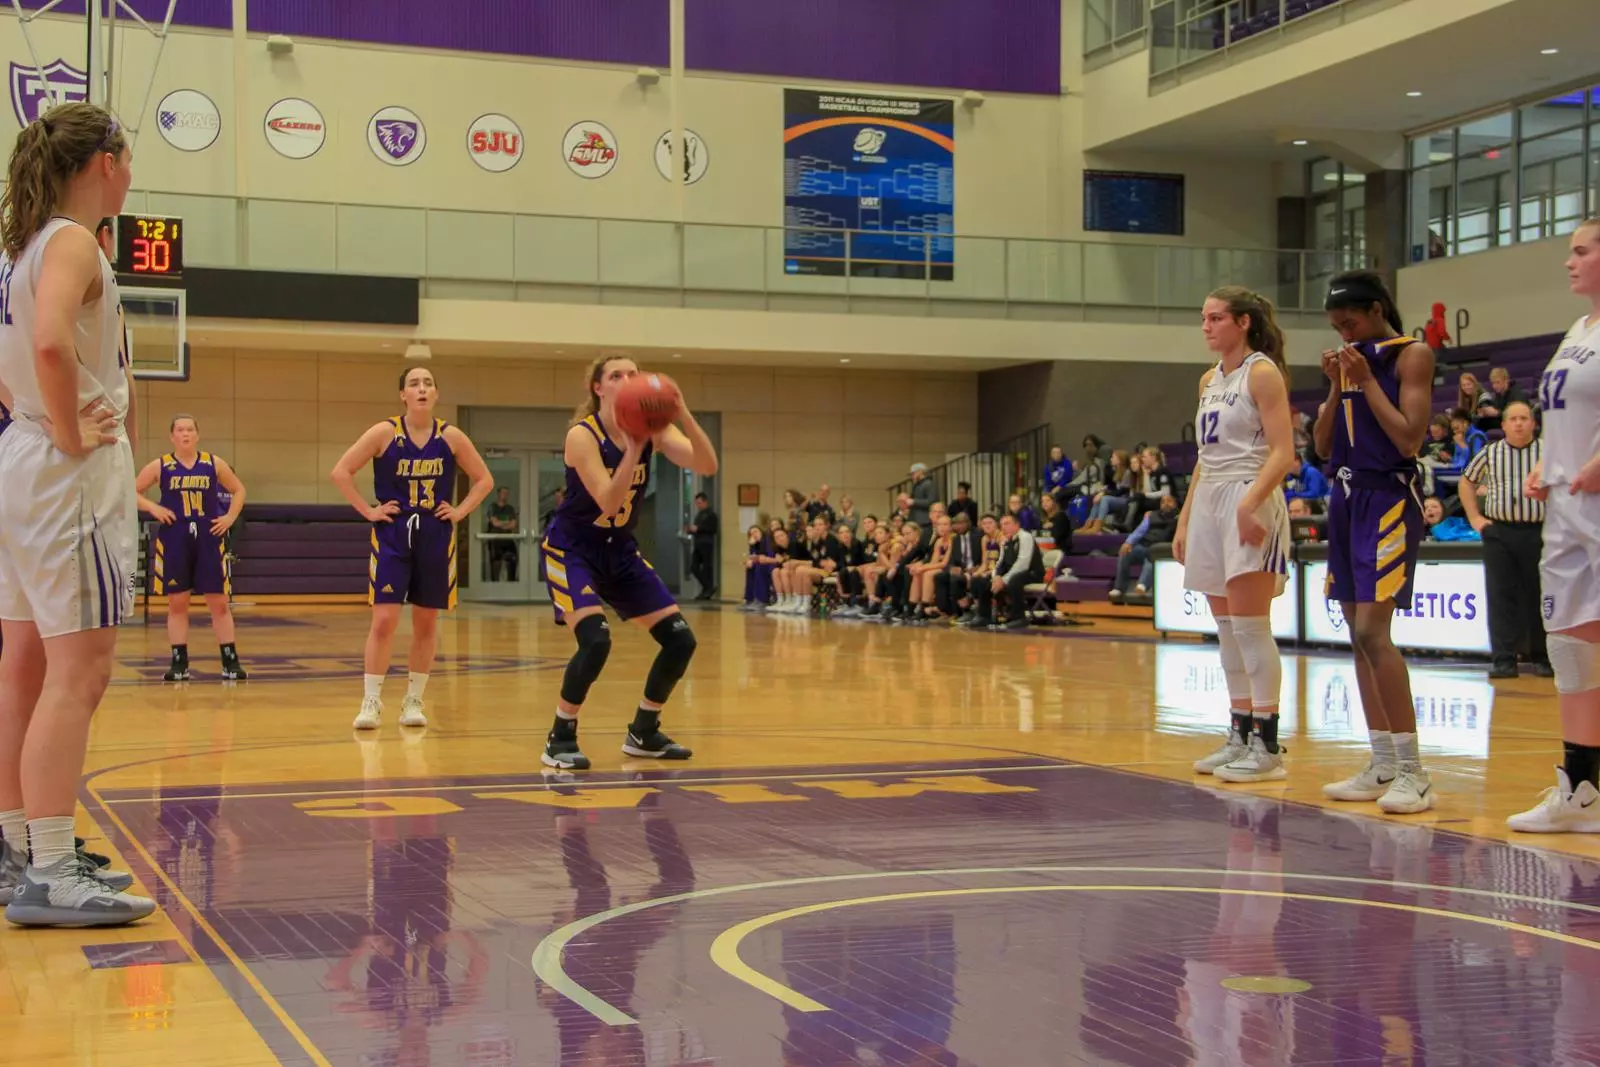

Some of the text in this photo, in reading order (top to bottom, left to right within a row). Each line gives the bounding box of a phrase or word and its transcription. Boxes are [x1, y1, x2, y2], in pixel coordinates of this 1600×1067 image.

[819, 102, 920, 116] BASKETBALL CHAMPIONSHIP
[472, 131, 520, 157] SJU
[861, 197, 879, 206] UST
[137, 220, 178, 240] 7:21
[133, 239, 169, 272] 30
[1201, 410, 1219, 446] 12
[1342, 398, 1354, 447] 1
[181, 490, 205, 517] 14
[408, 479, 436, 509] 13
